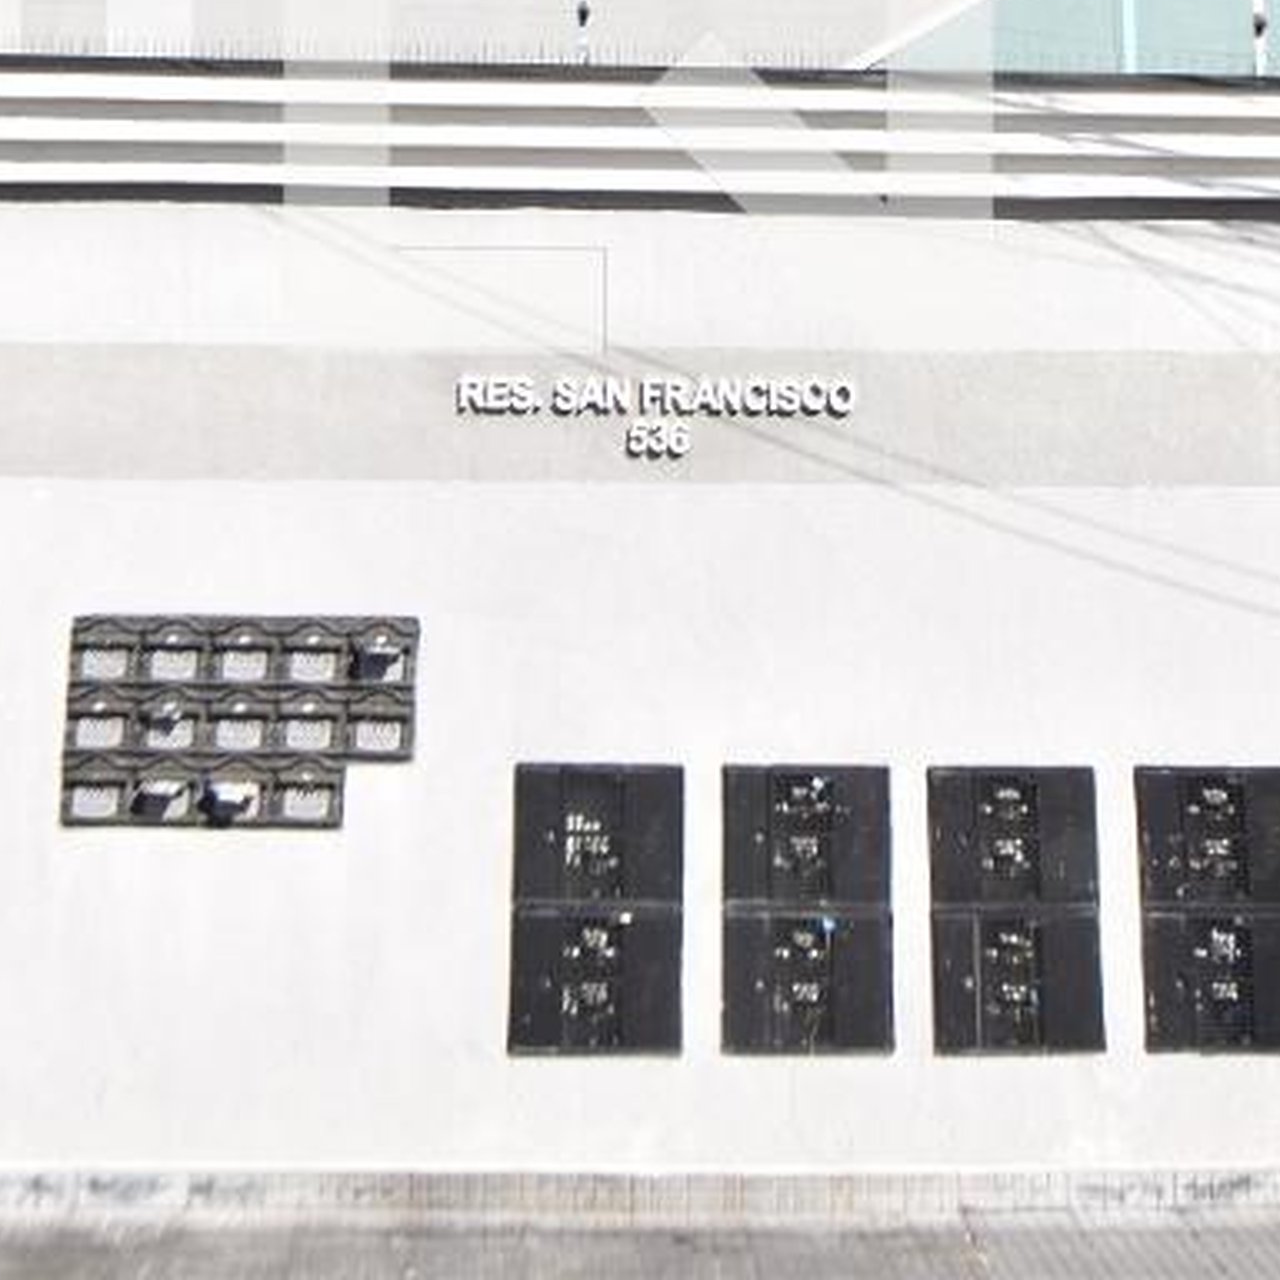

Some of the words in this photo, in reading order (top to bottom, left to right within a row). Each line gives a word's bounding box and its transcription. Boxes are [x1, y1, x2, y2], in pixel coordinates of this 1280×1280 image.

[455, 375, 542, 416] RES.
[550, 375, 630, 417] SAN
[638, 375, 856, 419] FRANCISCO
[626, 422, 690, 461] 536
